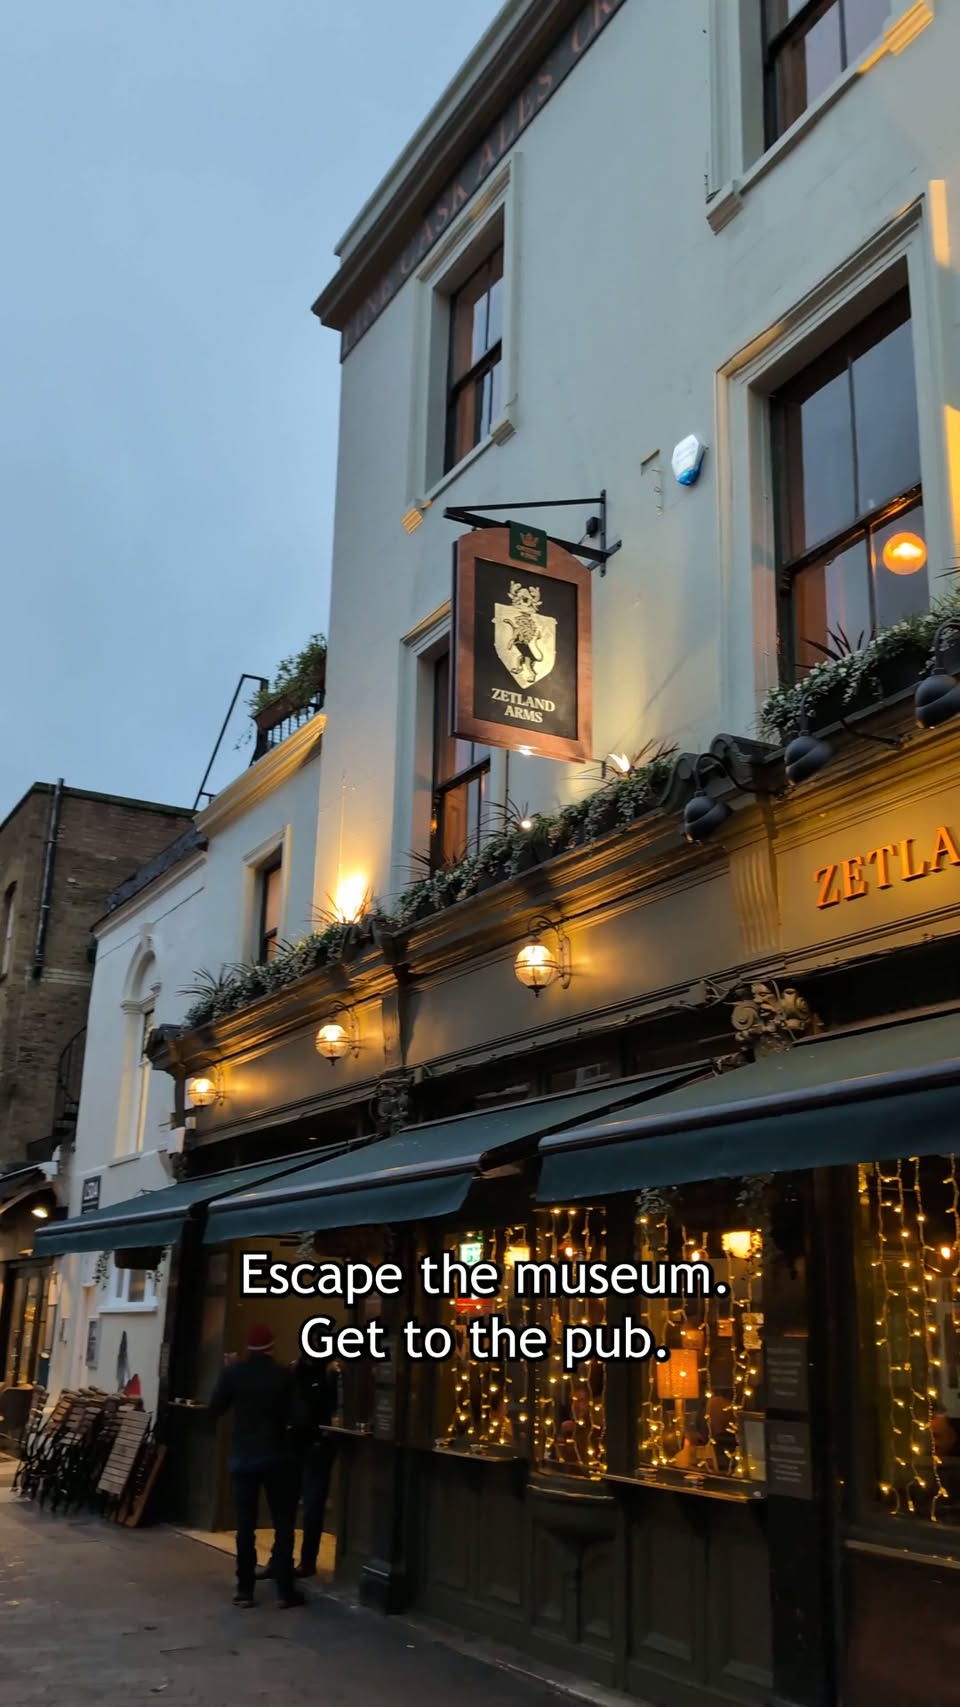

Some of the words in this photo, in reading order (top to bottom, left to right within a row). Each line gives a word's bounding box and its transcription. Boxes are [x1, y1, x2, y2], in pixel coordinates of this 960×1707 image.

[478, 72, 553, 179] ALES
[491, 687, 556, 712] ZETLAND
[503, 704, 543, 723] ARMS
[813, 825, 960, 909] ZETLA
